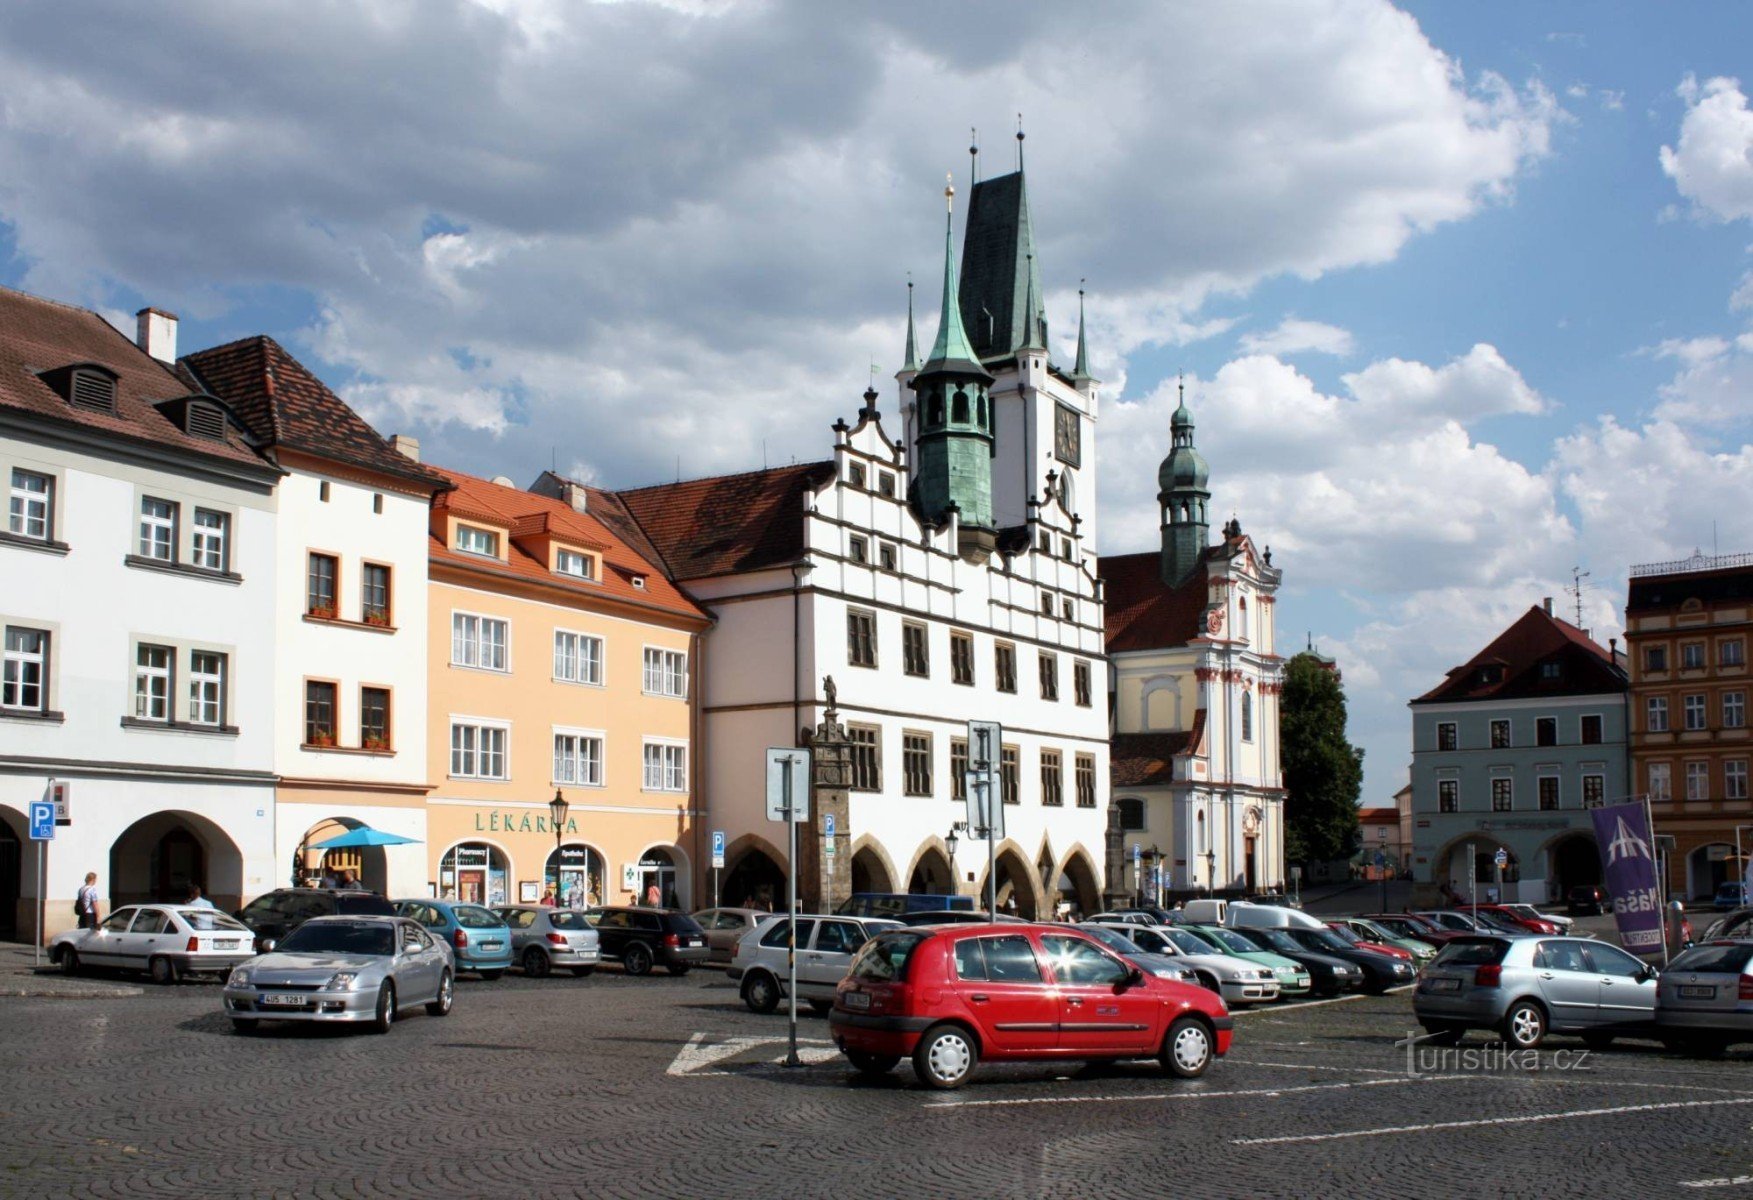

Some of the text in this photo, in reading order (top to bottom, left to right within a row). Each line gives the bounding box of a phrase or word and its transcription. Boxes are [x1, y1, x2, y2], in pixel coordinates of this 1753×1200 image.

[35, 806, 50, 828] P
[715, 834, 722, 849] P
[285, 996, 303, 1004] 1281
